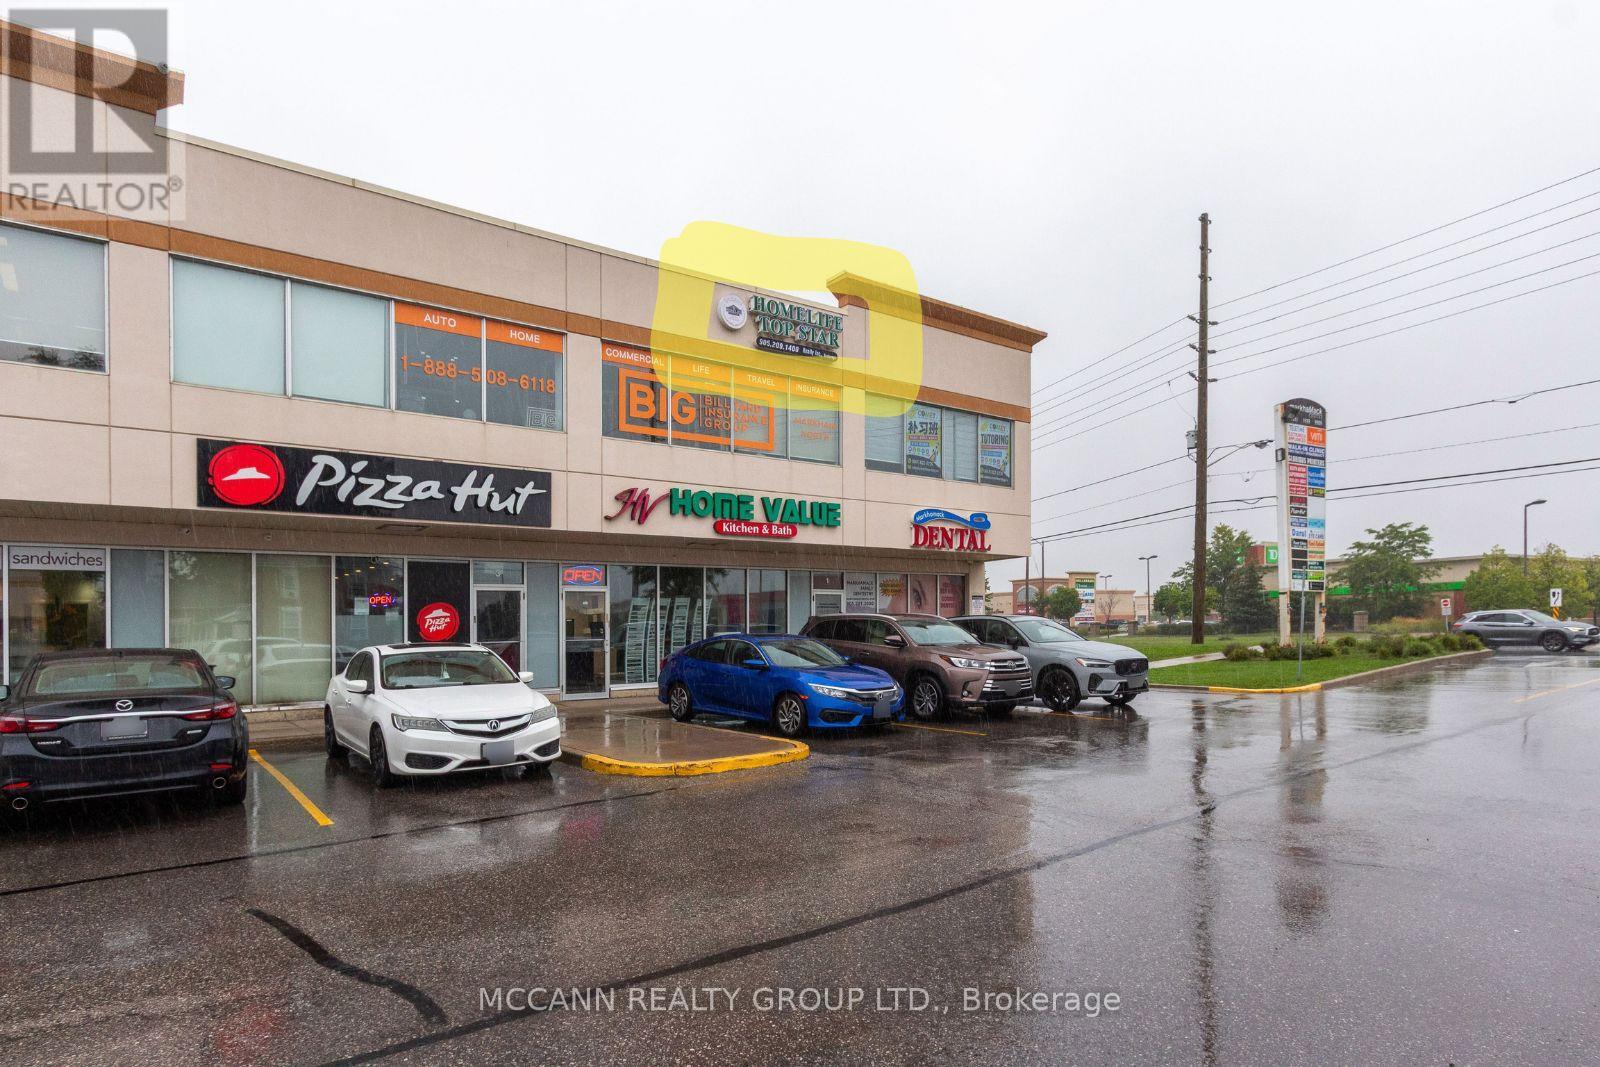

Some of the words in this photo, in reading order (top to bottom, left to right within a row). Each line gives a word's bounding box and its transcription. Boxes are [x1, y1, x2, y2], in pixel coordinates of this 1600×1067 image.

[424, 313, 457, 328] AUTO
[751, 295, 843, 332] HOMELIFE
[509, 329, 541, 344] HOME
[757, 315, 794, 336] TOP
[798, 324, 840, 348] STAR
[605, 347, 665, 367] COMMERCIAL
[401, 355, 556, 394] 1-888-508-6118
[692, 364, 710, 375] LIFE
[747, 374, 776, 387] TRAVEL
[795, 382, 835, 398] INSURANCE
[629, 382, 697, 426] BIG
[908, 420, 939, 436] 补习班
[981, 433, 1009, 445] TUTORING
[296, 454, 446, 509] Pizza
[450, 469, 548, 516] Hut
[669, 487, 755, 520] HOME
[761, 496, 842, 527] VALUE
[722, 521, 759, 534] Kitchen
[762, 524, 769, 534] &
[771, 524, 793, 536] Bath
[912, 524, 992, 553] DENTAL
[12, 551, 103, 567] sandwiches
[563, 568, 603, 583] OPEN
[369, 595, 392, 605] OPEN
[424, 617, 451, 629] Pizza
[429, 623, 448, 633] Hut
